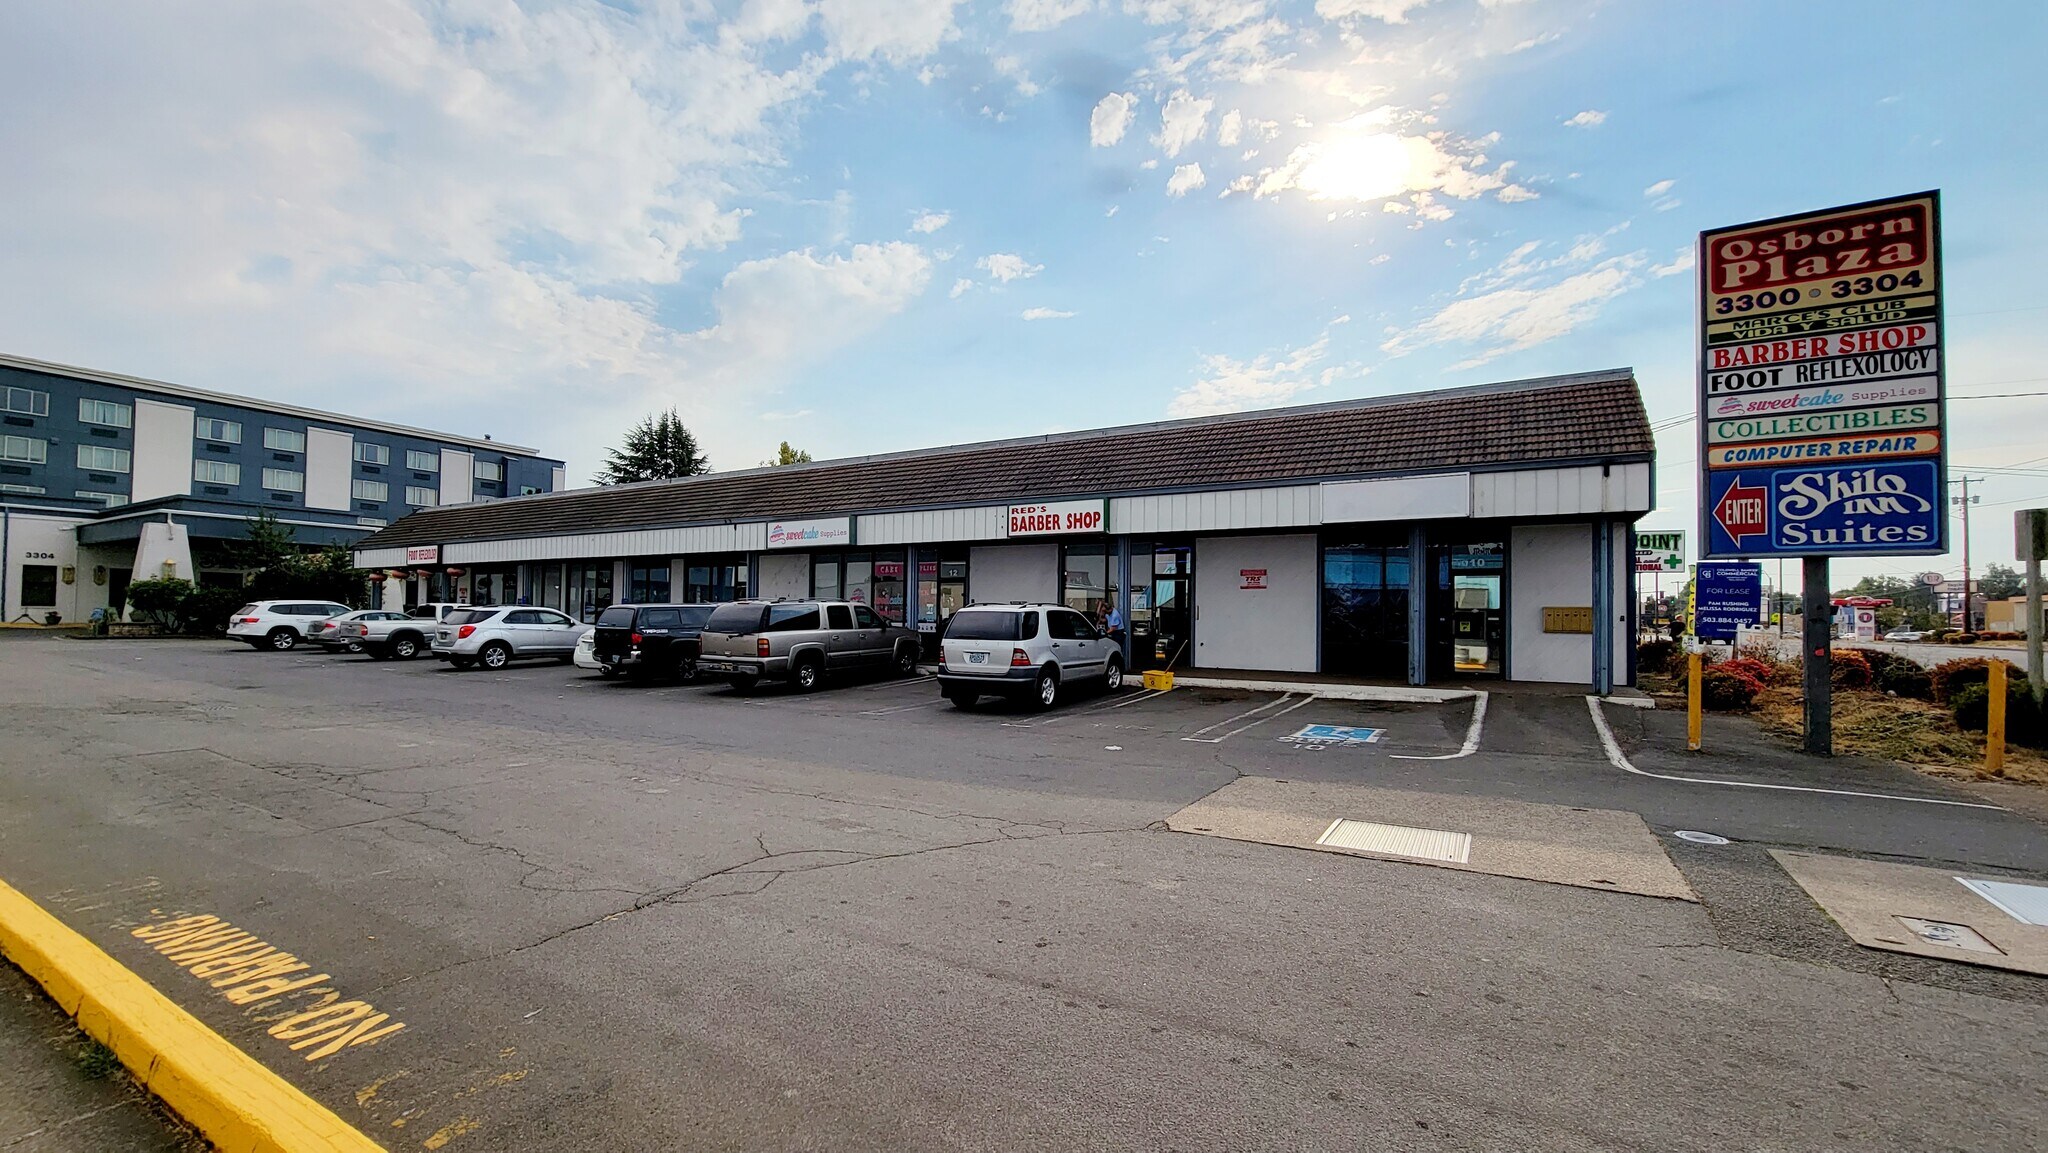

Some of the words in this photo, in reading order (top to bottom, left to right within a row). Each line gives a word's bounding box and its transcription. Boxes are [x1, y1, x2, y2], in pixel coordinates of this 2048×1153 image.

[1720, 216, 1915, 260] Osborn
[1721, 242, 1918, 289] Plaza
[1715, 287, 1800, 315] 3300
[1831, 270, 1923, 299] 3304
[1733, 309, 1831, 330] MARCE'S
[1841, 300, 1906, 316] CLUB
[1733, 325, 1789, 339] VIDA
[1800, 321, 1814, 331] Y
[1826, 310, 1907, 328] SALUD
[1713, 337, 1828, 369] BARBER
[1838, 325, 1927, 353] SHOP
[1711, 368, 1783, 392] FOOT
[1796, 349, 1931, 384] REFLEXOLOGY
[1747, 389, 1844, 412] sweetcake
[1851, 386, 1927, 401] Supplies
[1717, 407, 1928, 439] COLLECTIBLES
[1724, 443, 1832, 463] COMPUTER
[1838, 436, 1917, 455] REPAIR
[1778, 468, 1931, 521] Shilo
[1011, 505, 1047, 514] RED'S
[1011, 514, 1061, 532] BARBER
[1067, 511, 1101, 529] SHOP
[1725, 498, 1762, 525] ENTER
[1636, 533, 1682, 551] OINT
[1781, 520, 1928, 545] Suites
[25, 551, 55, 559] 3304
[1470, 558, 1485, 567] 10
[131, 913, 331, 1005] PARKING
[267, 1000, 407, 1062] NO
